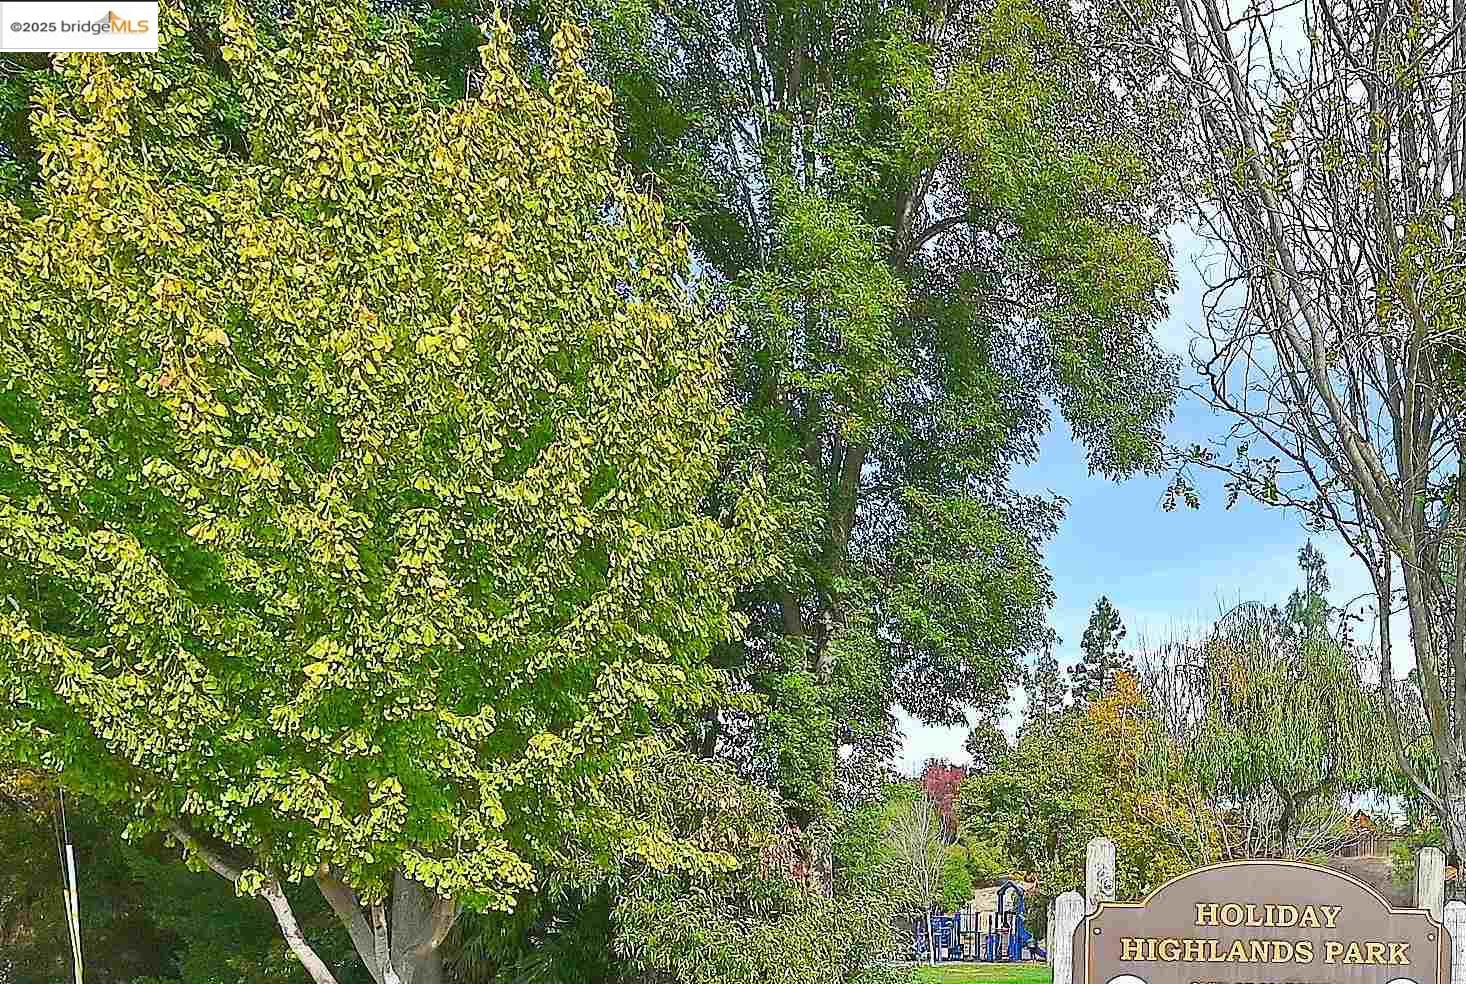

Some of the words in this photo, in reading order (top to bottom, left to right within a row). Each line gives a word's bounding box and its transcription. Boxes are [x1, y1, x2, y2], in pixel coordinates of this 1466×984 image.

[1195, 903, 1342, 928] HOLIDAY
[1120, 937, 1314, 963] HIGHLANDS
[1324, 941, 1411, 965] PARK
